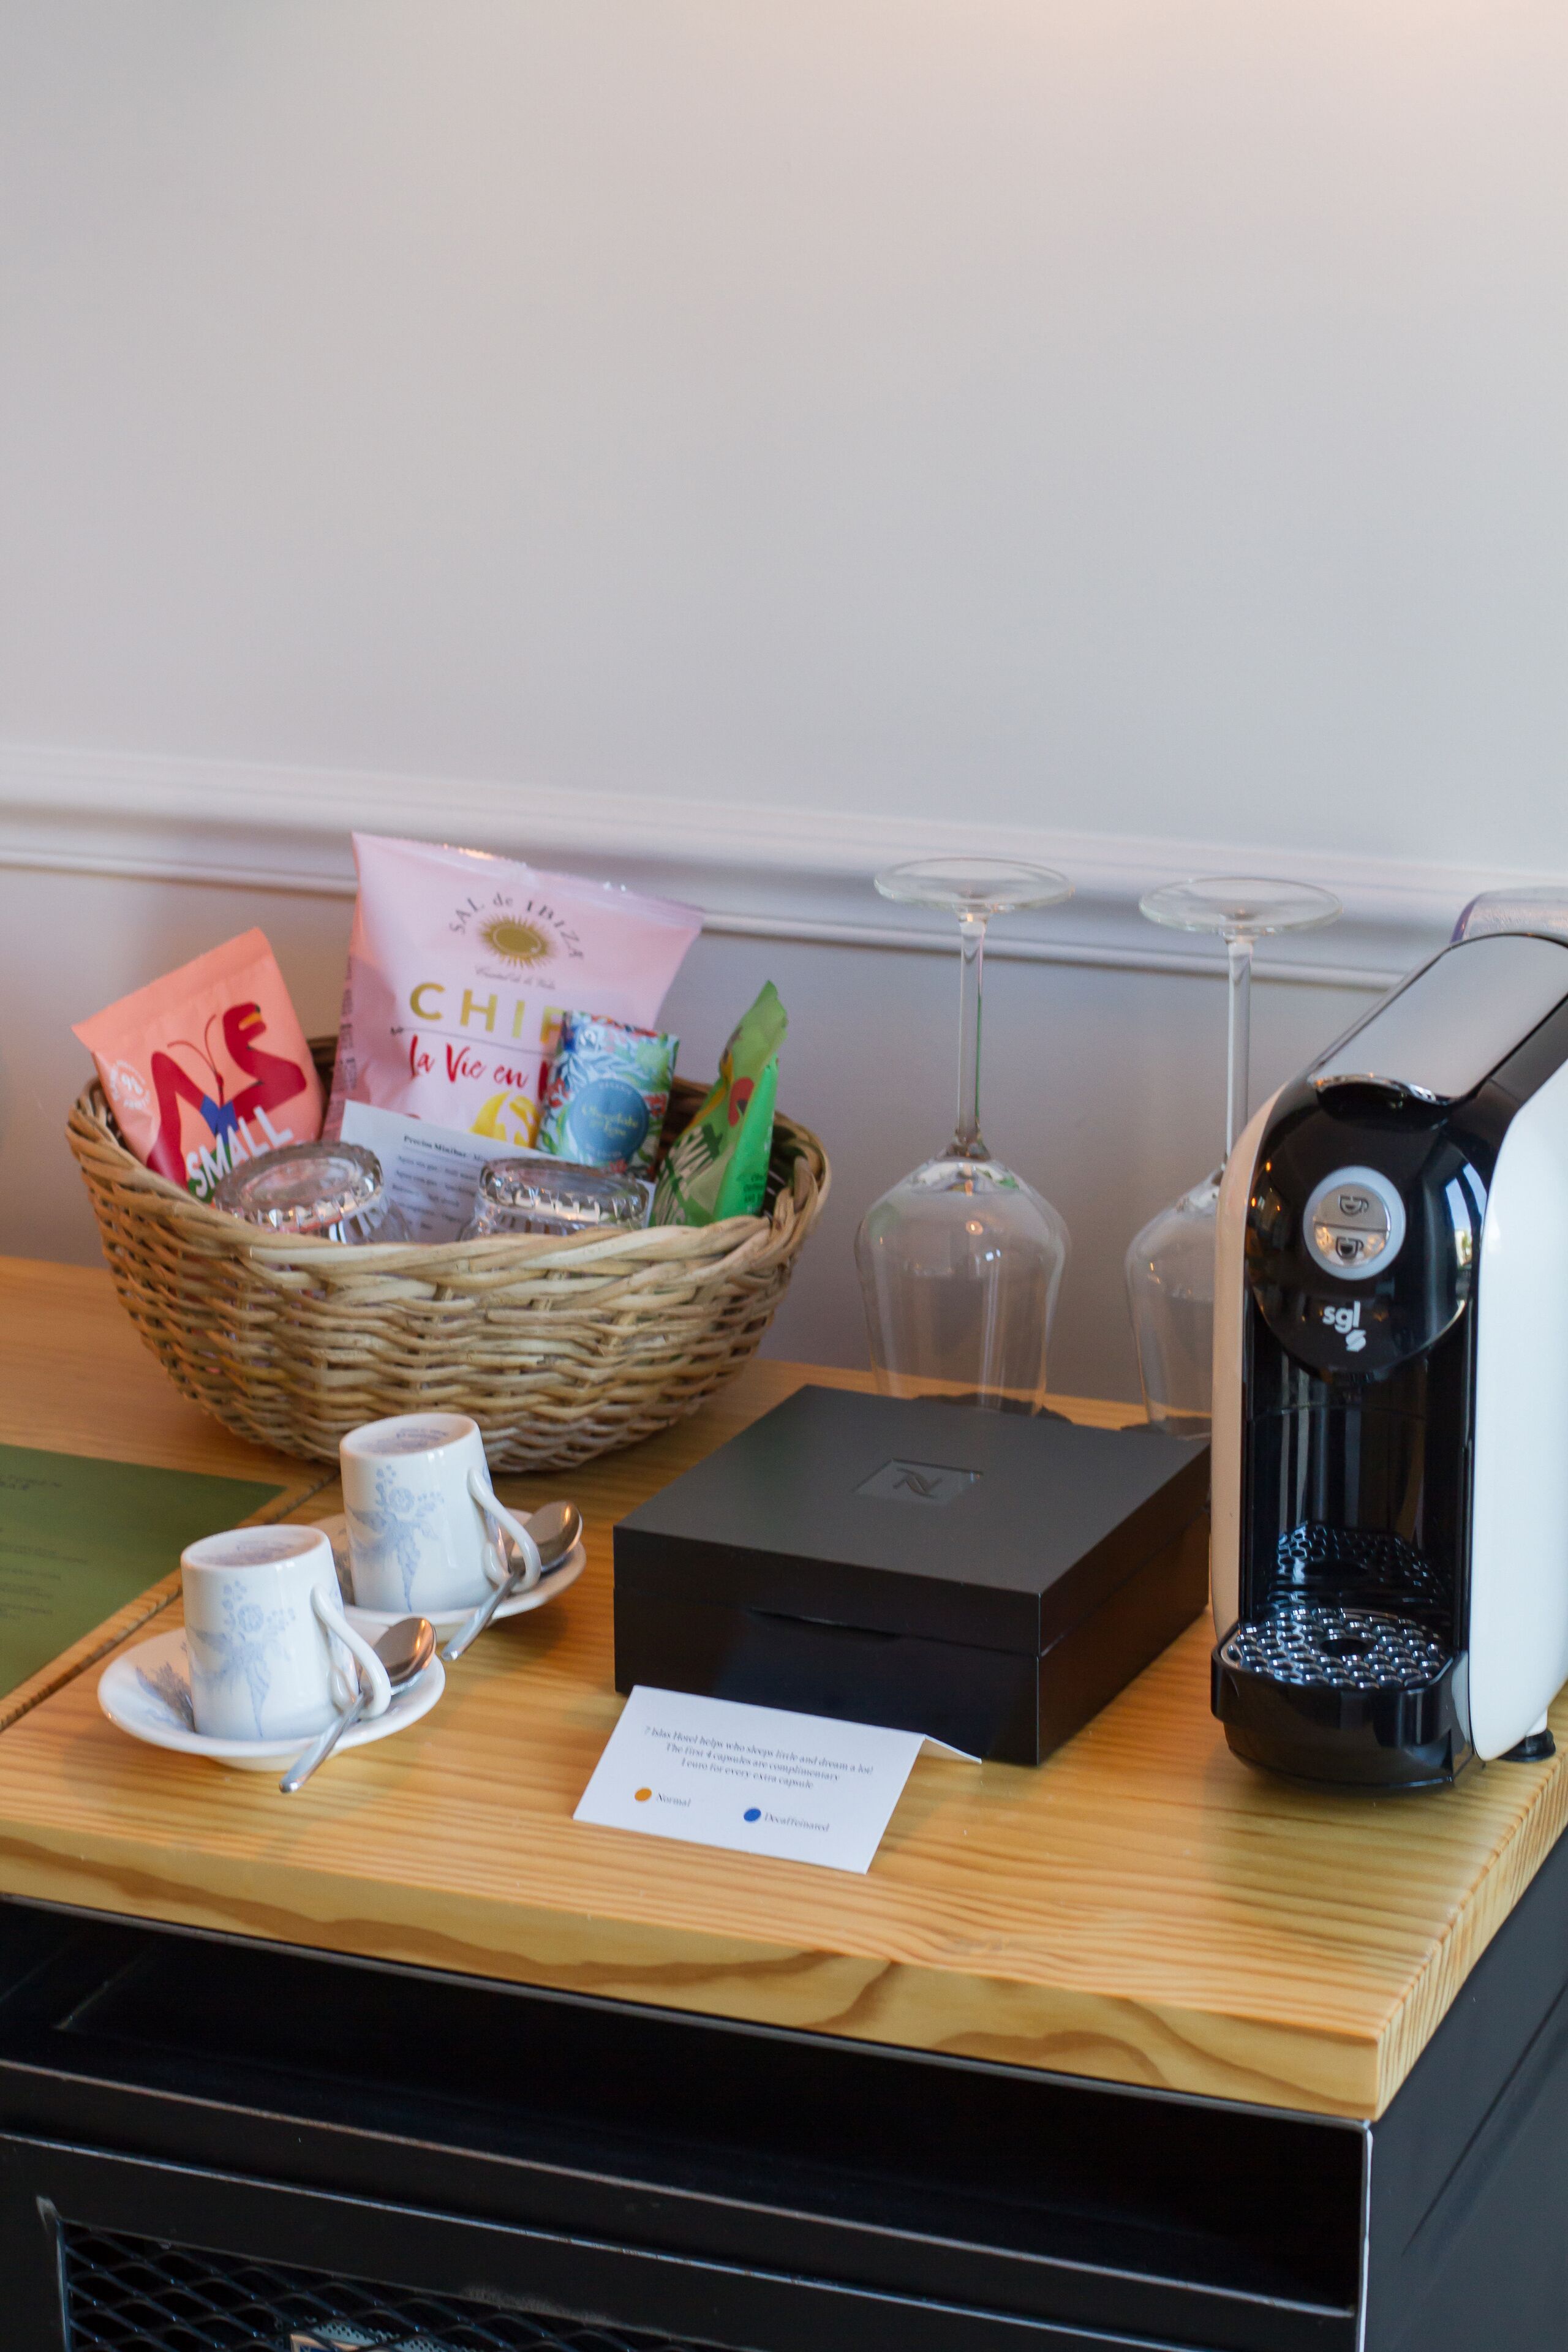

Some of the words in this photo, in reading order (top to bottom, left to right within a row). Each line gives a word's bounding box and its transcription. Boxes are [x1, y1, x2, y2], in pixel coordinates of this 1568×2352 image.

[449, 898, 486, 935] SAL
[527, 900, 584, 959] IBIZA
[446, 1042, 487, 1083] Vie
[494, 1065, 529, 1088] en
[186, 1105, 293, 1197] SMALL
[1322, 1300, 1361, 1334] sgl
[666, 1743, 684, 1754] The
[684, 1746, 704, 1757] first
[713, 1753, 751, 1766] capsules
[752, 1760, 768, 1769] are
[769, 1762, 840, 1782] complimentary
[673, 1731, 698, 1744] Hotel
[699, 1734, 723, 1749] helps
[726, 1741, 745, 1752] who
[747, 1744, 774, 1758] sleeps
[775, 1749, 799, 1761] little
[799, 1755, 818, 1765] and
[818, 1757, 848, 1770] dream
[709, 1763, 723, 1773] for
[725, 1768, 750, 1778] every
[752, 1772, 777, 1783] extra
[778, 1777, 814, 1789] capsule
[656, 1793, 692, 1807] Normal
[764, 1812, 831, 1833] Decaffeinated
